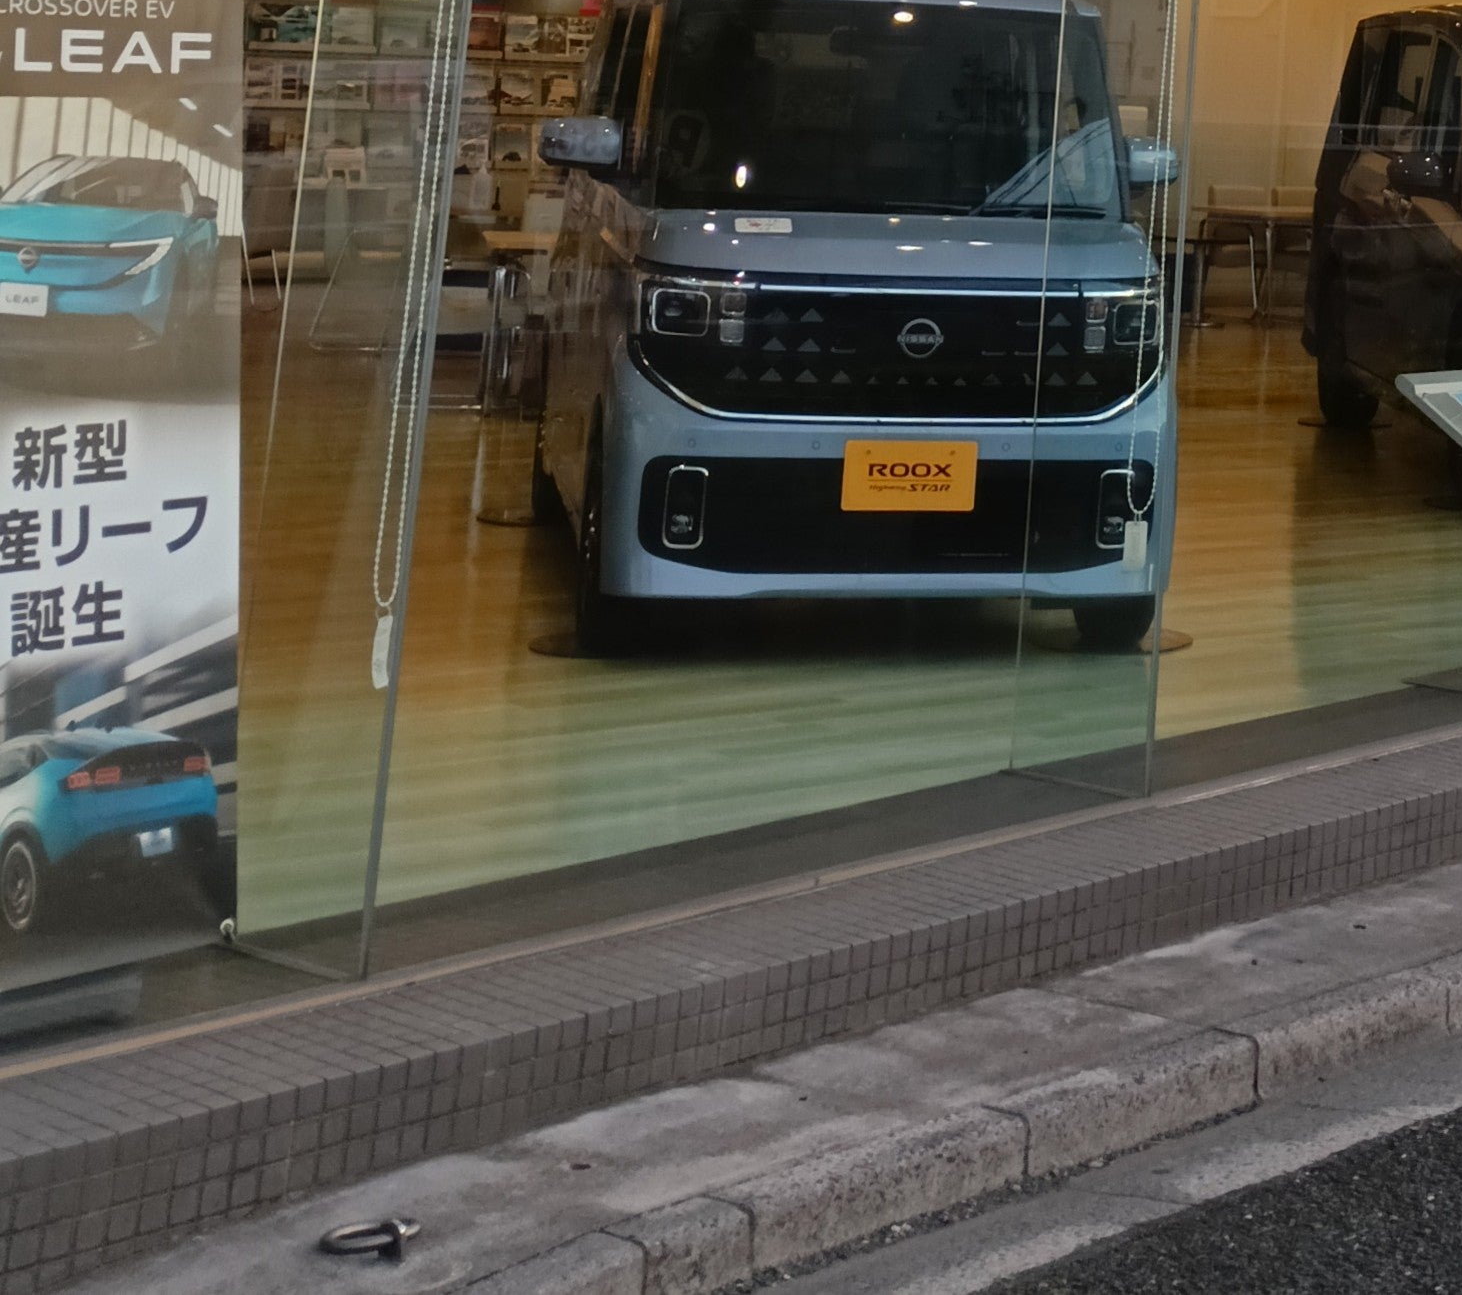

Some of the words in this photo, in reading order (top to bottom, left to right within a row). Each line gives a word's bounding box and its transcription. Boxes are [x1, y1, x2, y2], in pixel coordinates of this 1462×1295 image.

[145, 0, 175, 19] EV
[14, 27, 213, 74] LEAF
[11, 419, 128, 492] 新型
[867, 462, 953, 478] ROOX
[907, 483, 951, 492] STAR
[10, 580, 125, 658] 誕生
